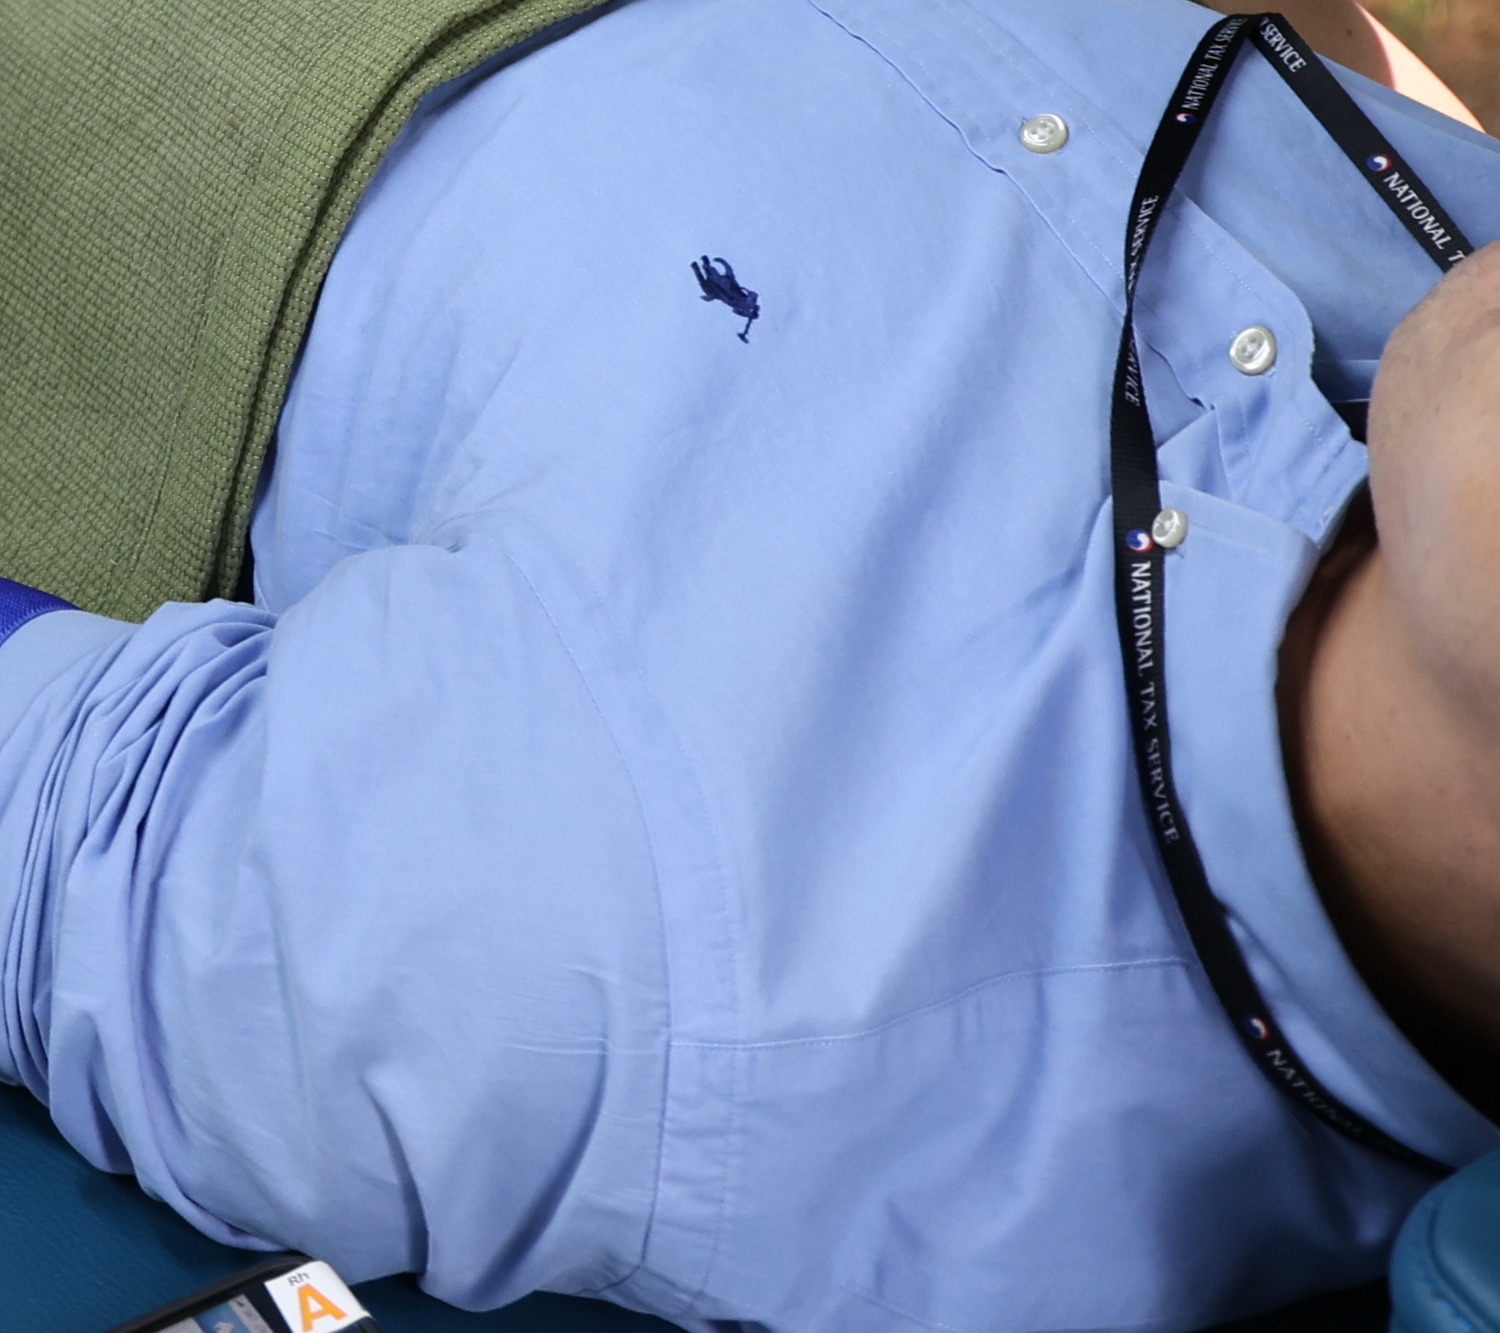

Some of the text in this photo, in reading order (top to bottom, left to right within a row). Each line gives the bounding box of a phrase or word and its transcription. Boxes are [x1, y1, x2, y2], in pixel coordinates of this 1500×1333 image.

[1182, 63, 1218, 110] NATIONAL
[1204, 43, 1228, 61] TAX
[1260, 23, 1307, 73] SERVICE
[1383, 171, 1450, 250] NATIONAL
[1131, 561, 1179, 843] NATIONAL TAX SERVICE
[287, 1272, 311, 1286] Rh
[297, 1283, 348, 1332] A
